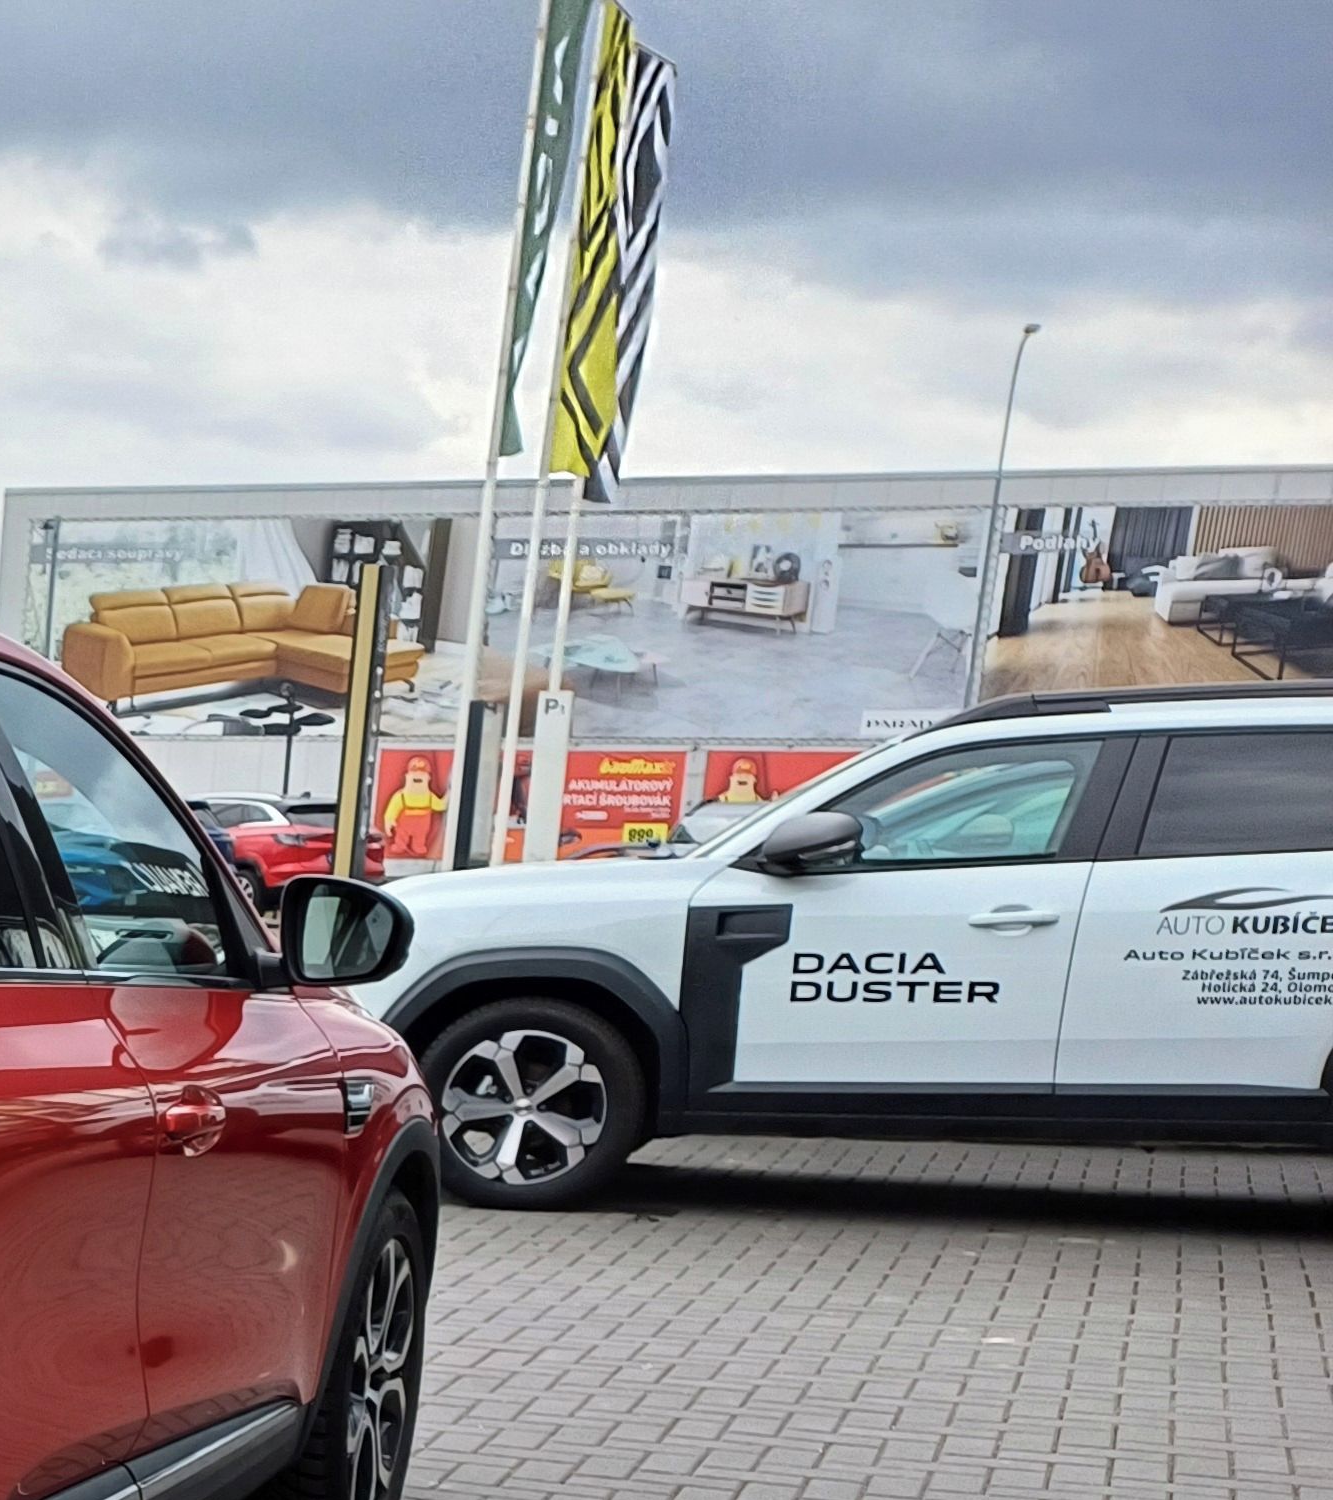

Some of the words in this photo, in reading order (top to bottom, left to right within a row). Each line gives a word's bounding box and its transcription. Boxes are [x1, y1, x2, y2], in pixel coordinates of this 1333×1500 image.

[596, 541, 672, 558] obklady
[1019, 534, 1101, 553] Podlahy
[866, 719, 933, 730] PARAD
[563, 791, 598, 806] RTACÍ
[1156, 914, 1226, 936] AUTO
[1123, 948, 1185, 961] Auto
[1191, 946, 1290, 961] Kubíček
[792, 951, 946, 975] DACIA
[1262, 970, 1283, 983] 74,
[1288, 966, 1333, 982] Šump
[789, 980, 1001, 1004] DUSTER
[1201, 981, 1256, 994] Holická
[1261, 982, 1282, 995] 24,
